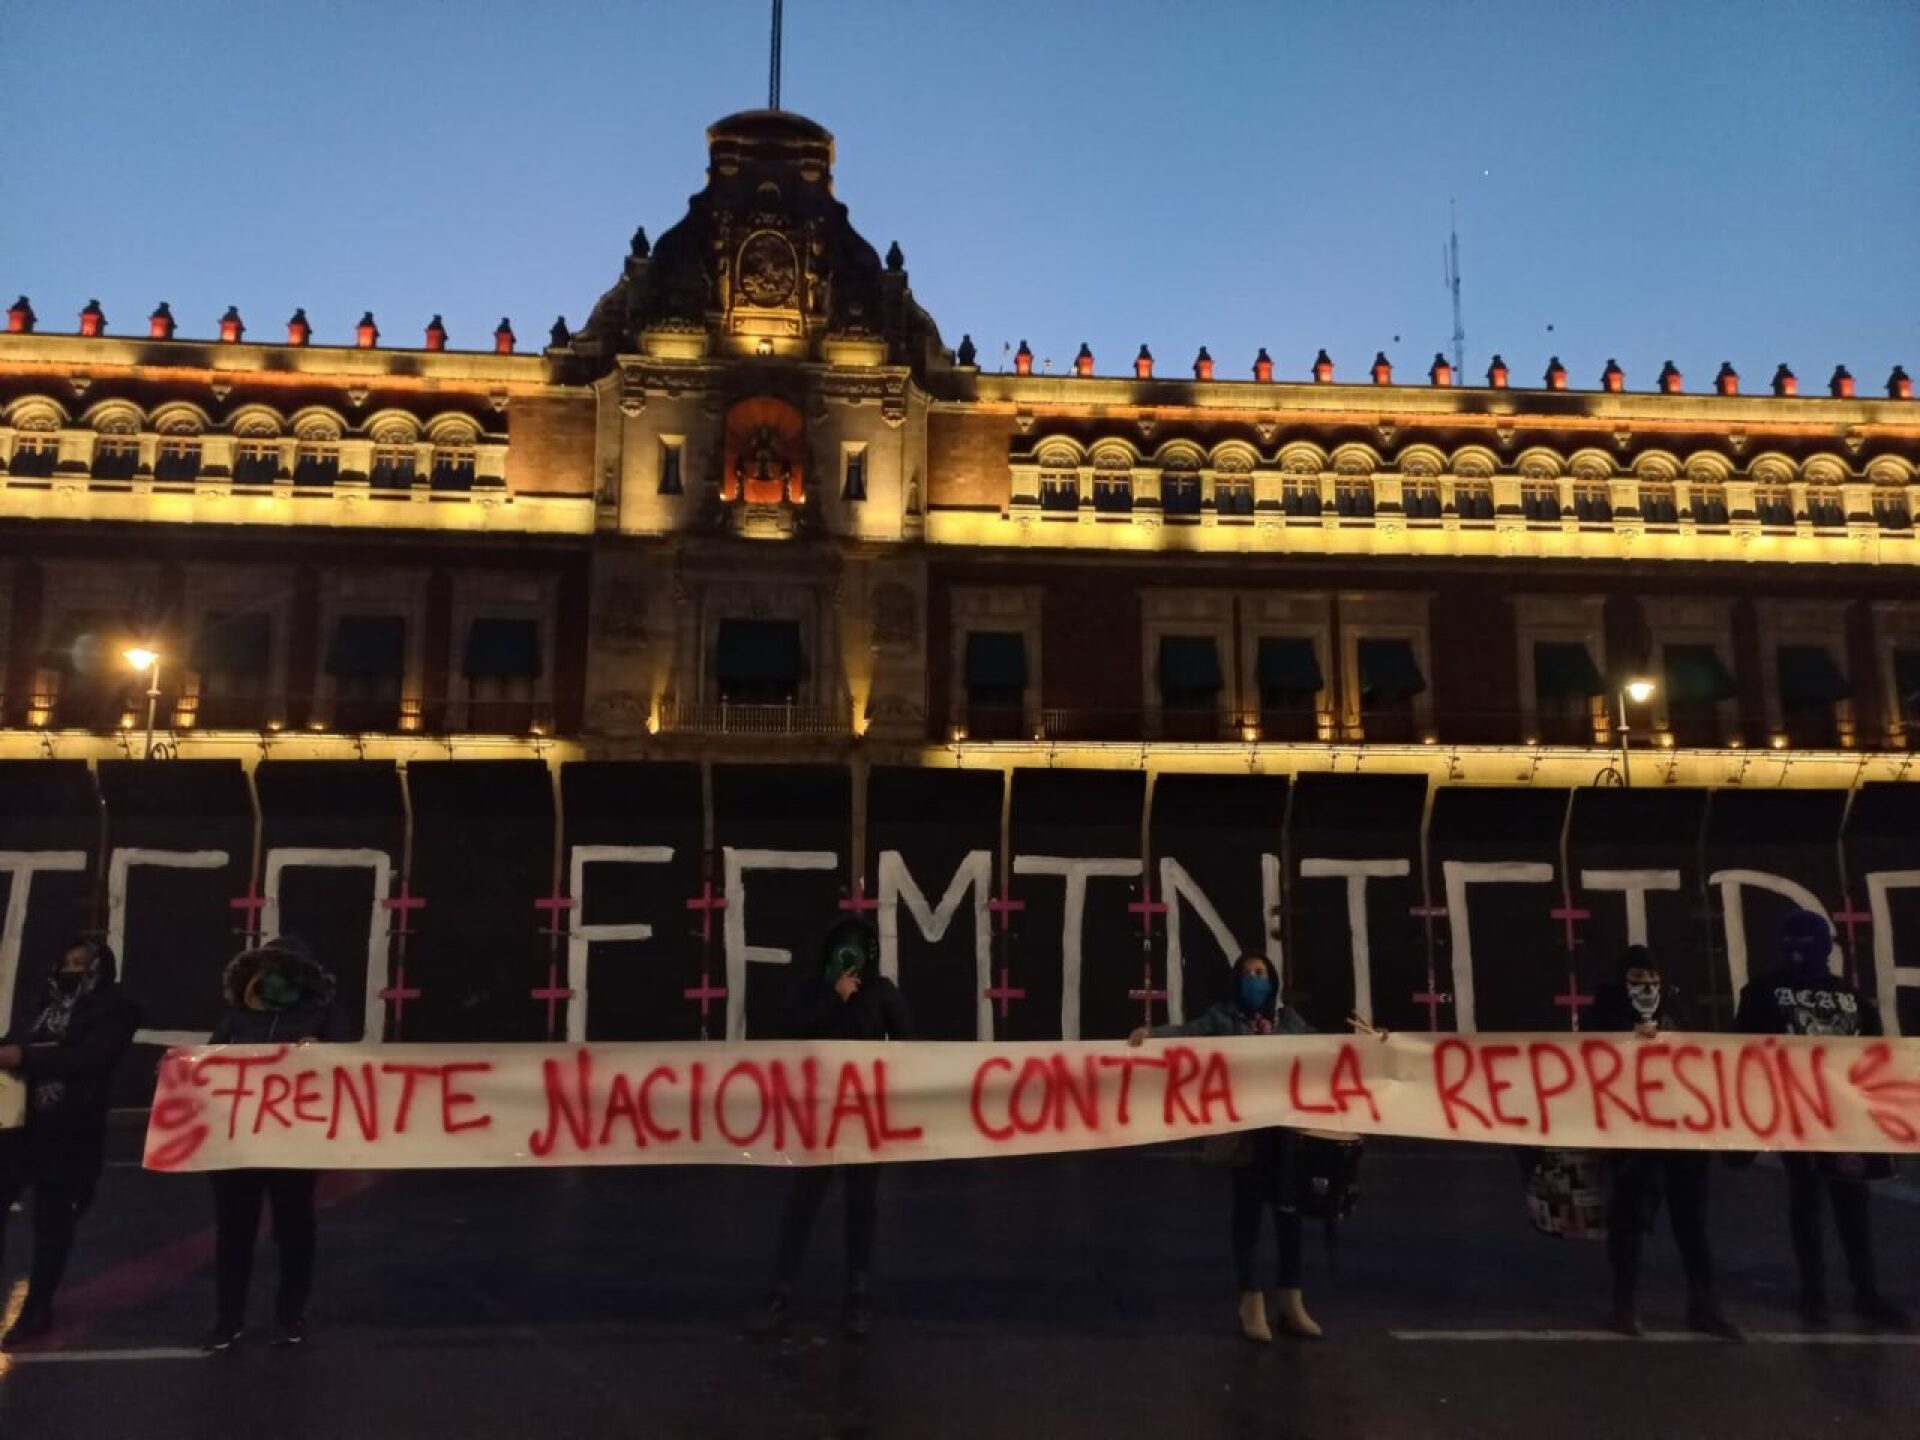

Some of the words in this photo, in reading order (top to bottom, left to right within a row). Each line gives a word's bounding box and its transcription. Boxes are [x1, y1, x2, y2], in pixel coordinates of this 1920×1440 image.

[194, 1046, 490, 1140] FRENTE
[530, 1049, 922, 1156] NACIONAL
[971, 1047, 1240, 1141] CONTRA
[1288, 1044, 1380, 1121] LA
[1433, 1037, 1834, 1138] REPRESIÓN
